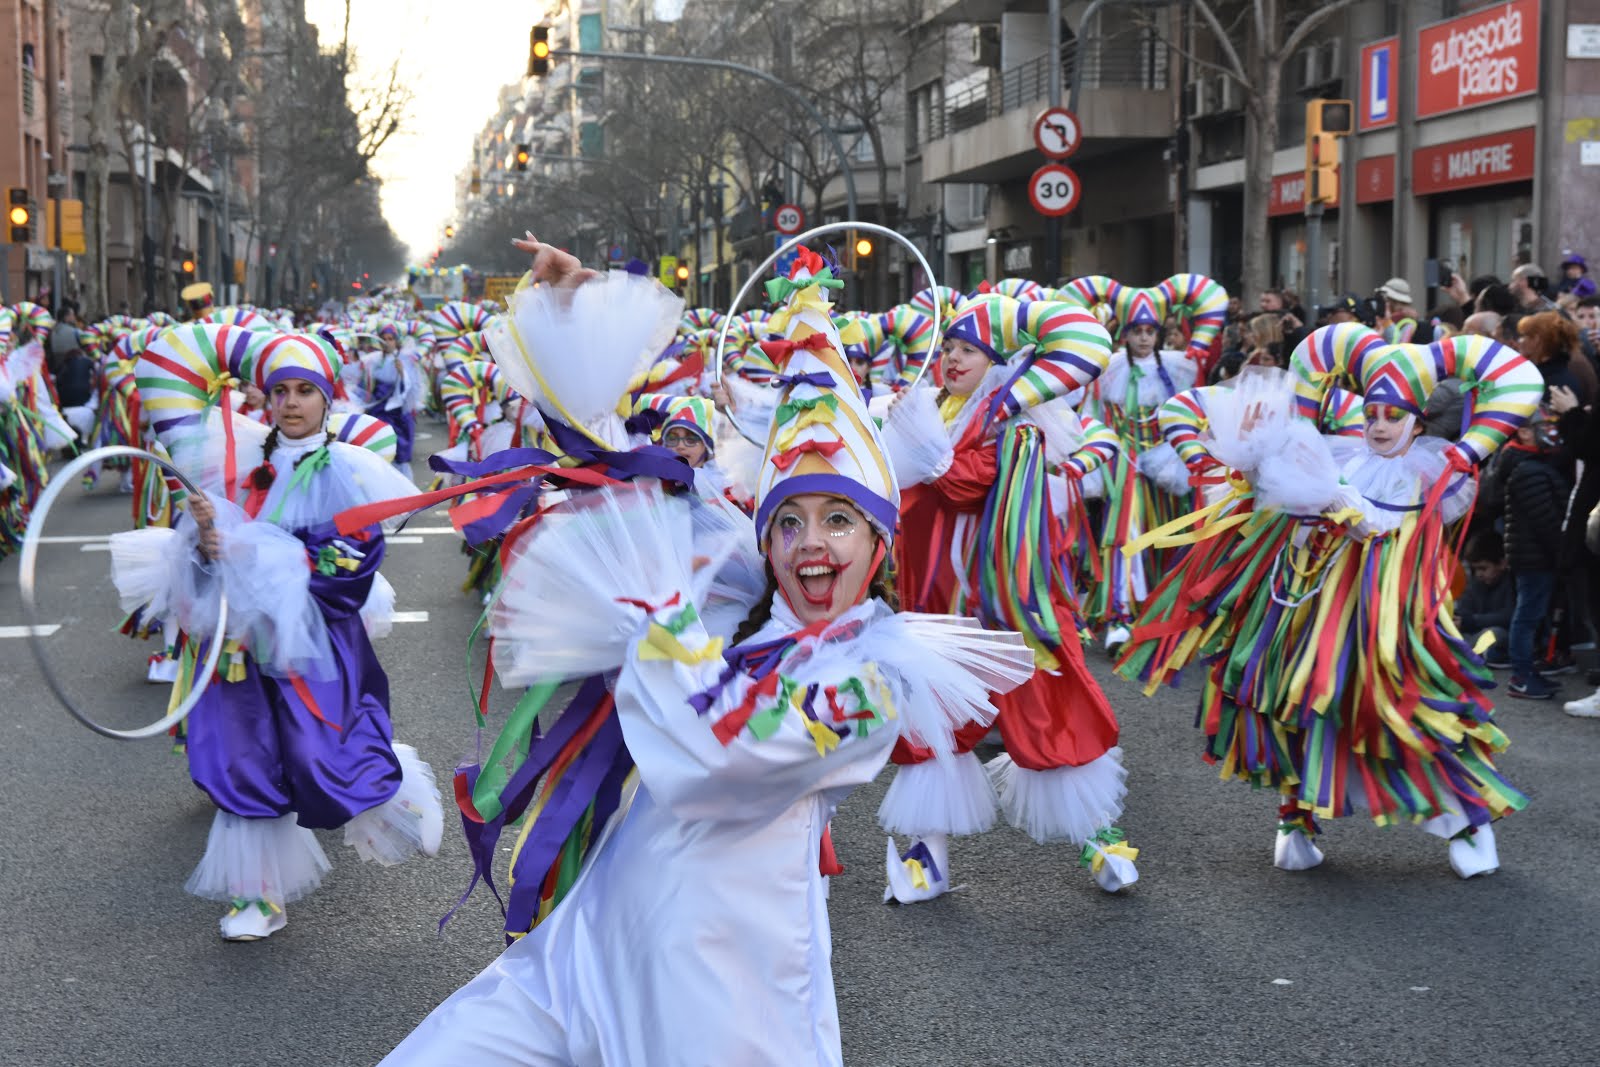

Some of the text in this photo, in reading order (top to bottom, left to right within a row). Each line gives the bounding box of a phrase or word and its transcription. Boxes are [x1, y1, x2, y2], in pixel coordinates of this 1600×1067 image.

[1431, 4, 1522, 75] autoescola
[1371, 54, 1387, 115] L
[1458, 57, 1518, 106] pallars
[1448, 143, 1513, 179] MAPFRE
[1040, 182, 1069, 199] 30
[1281, 179, 1305, 204] MAP
[780, 214, 798, 226] 30
